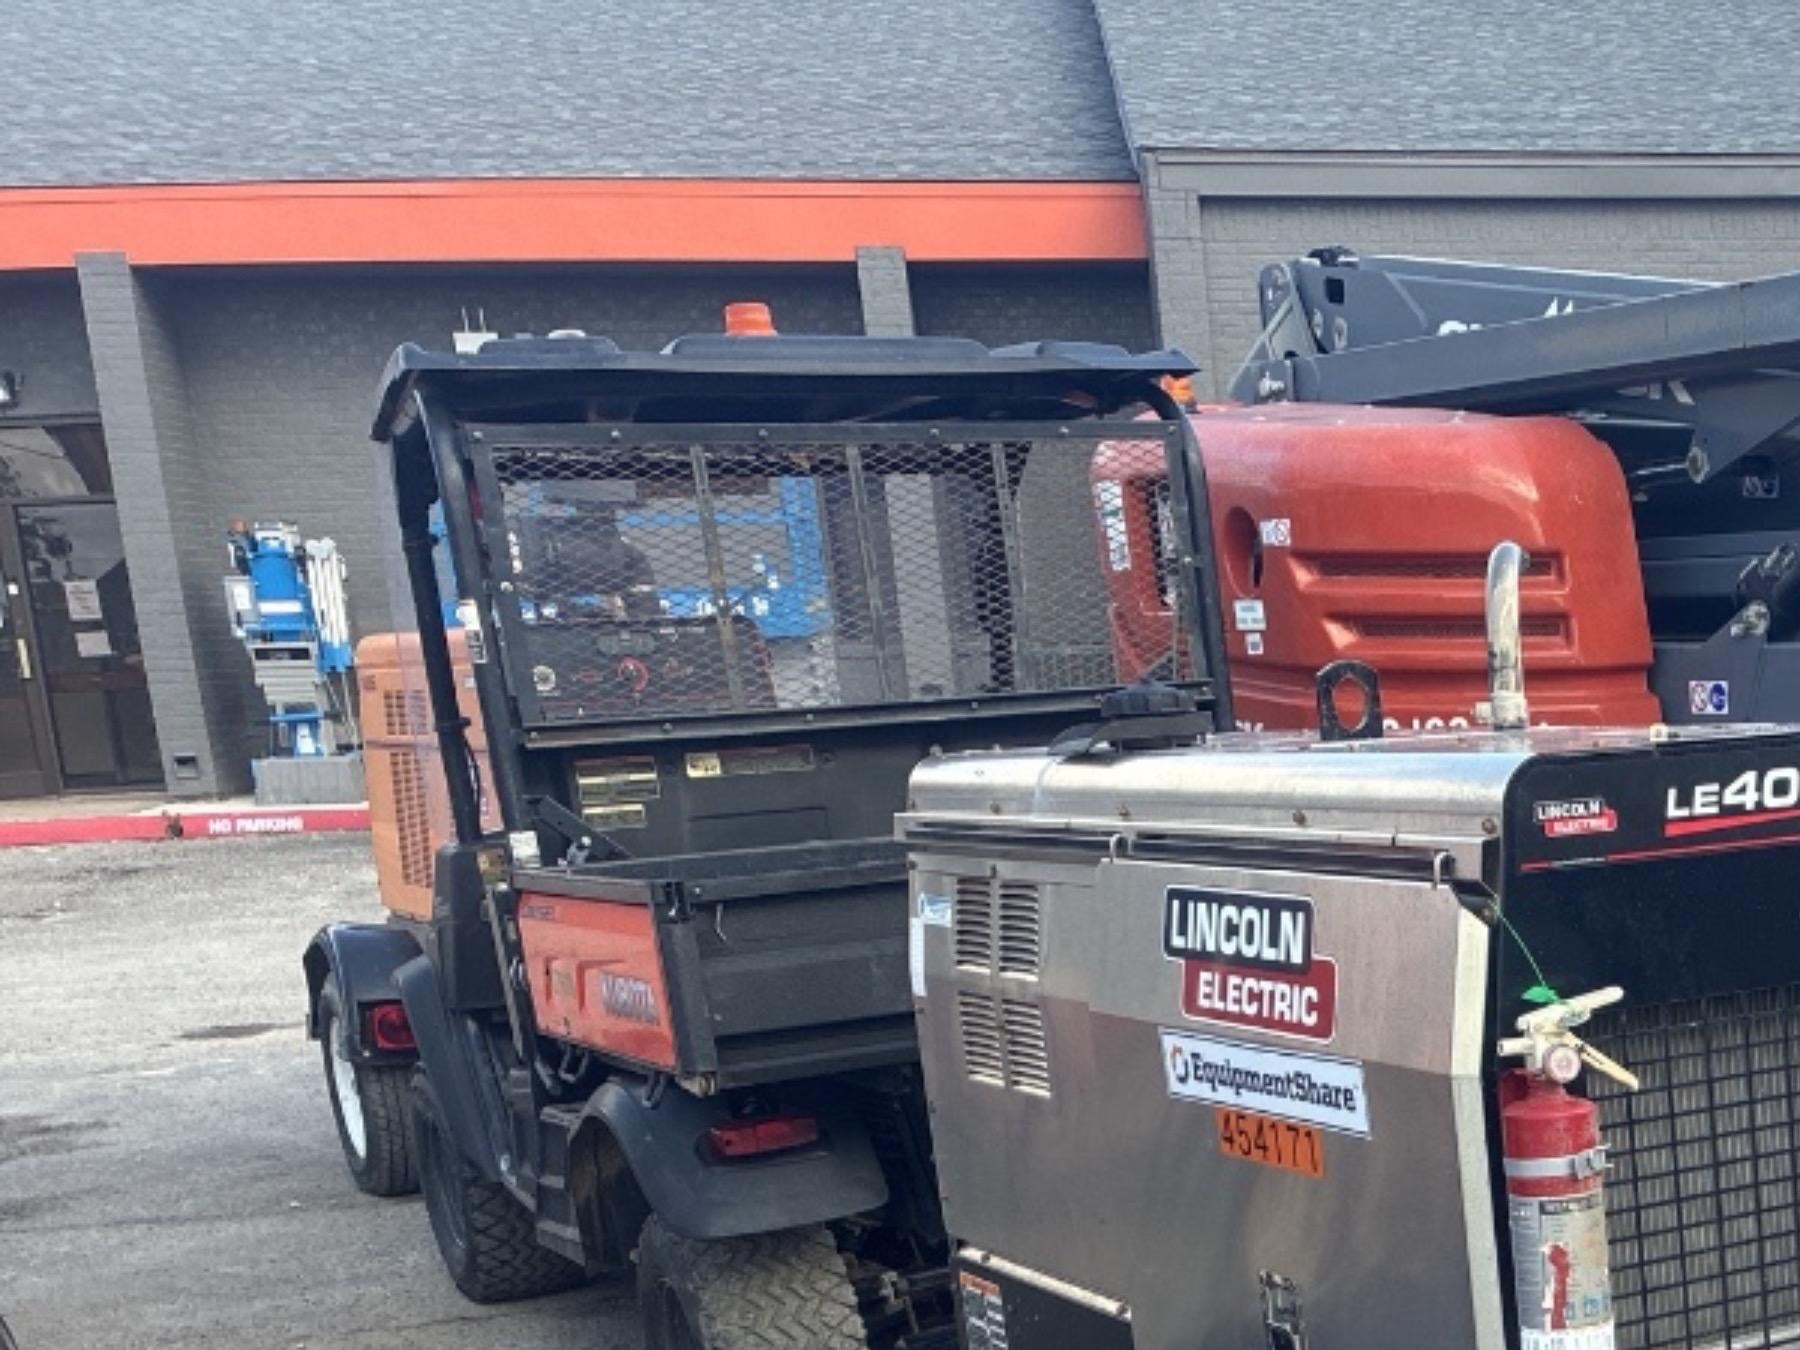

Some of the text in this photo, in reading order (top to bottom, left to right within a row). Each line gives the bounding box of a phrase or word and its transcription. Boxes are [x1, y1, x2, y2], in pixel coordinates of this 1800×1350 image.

[209, 816, 304, 835] NO PARKING
[1539, 799, 1600, 820] LINCOLN
[1170, 899, 1305, 964] LINCOLN
[1197, 971, 1318, 1026] ELECTRIC
[1191, 1052, 1356, 1112] EquipmentShare
